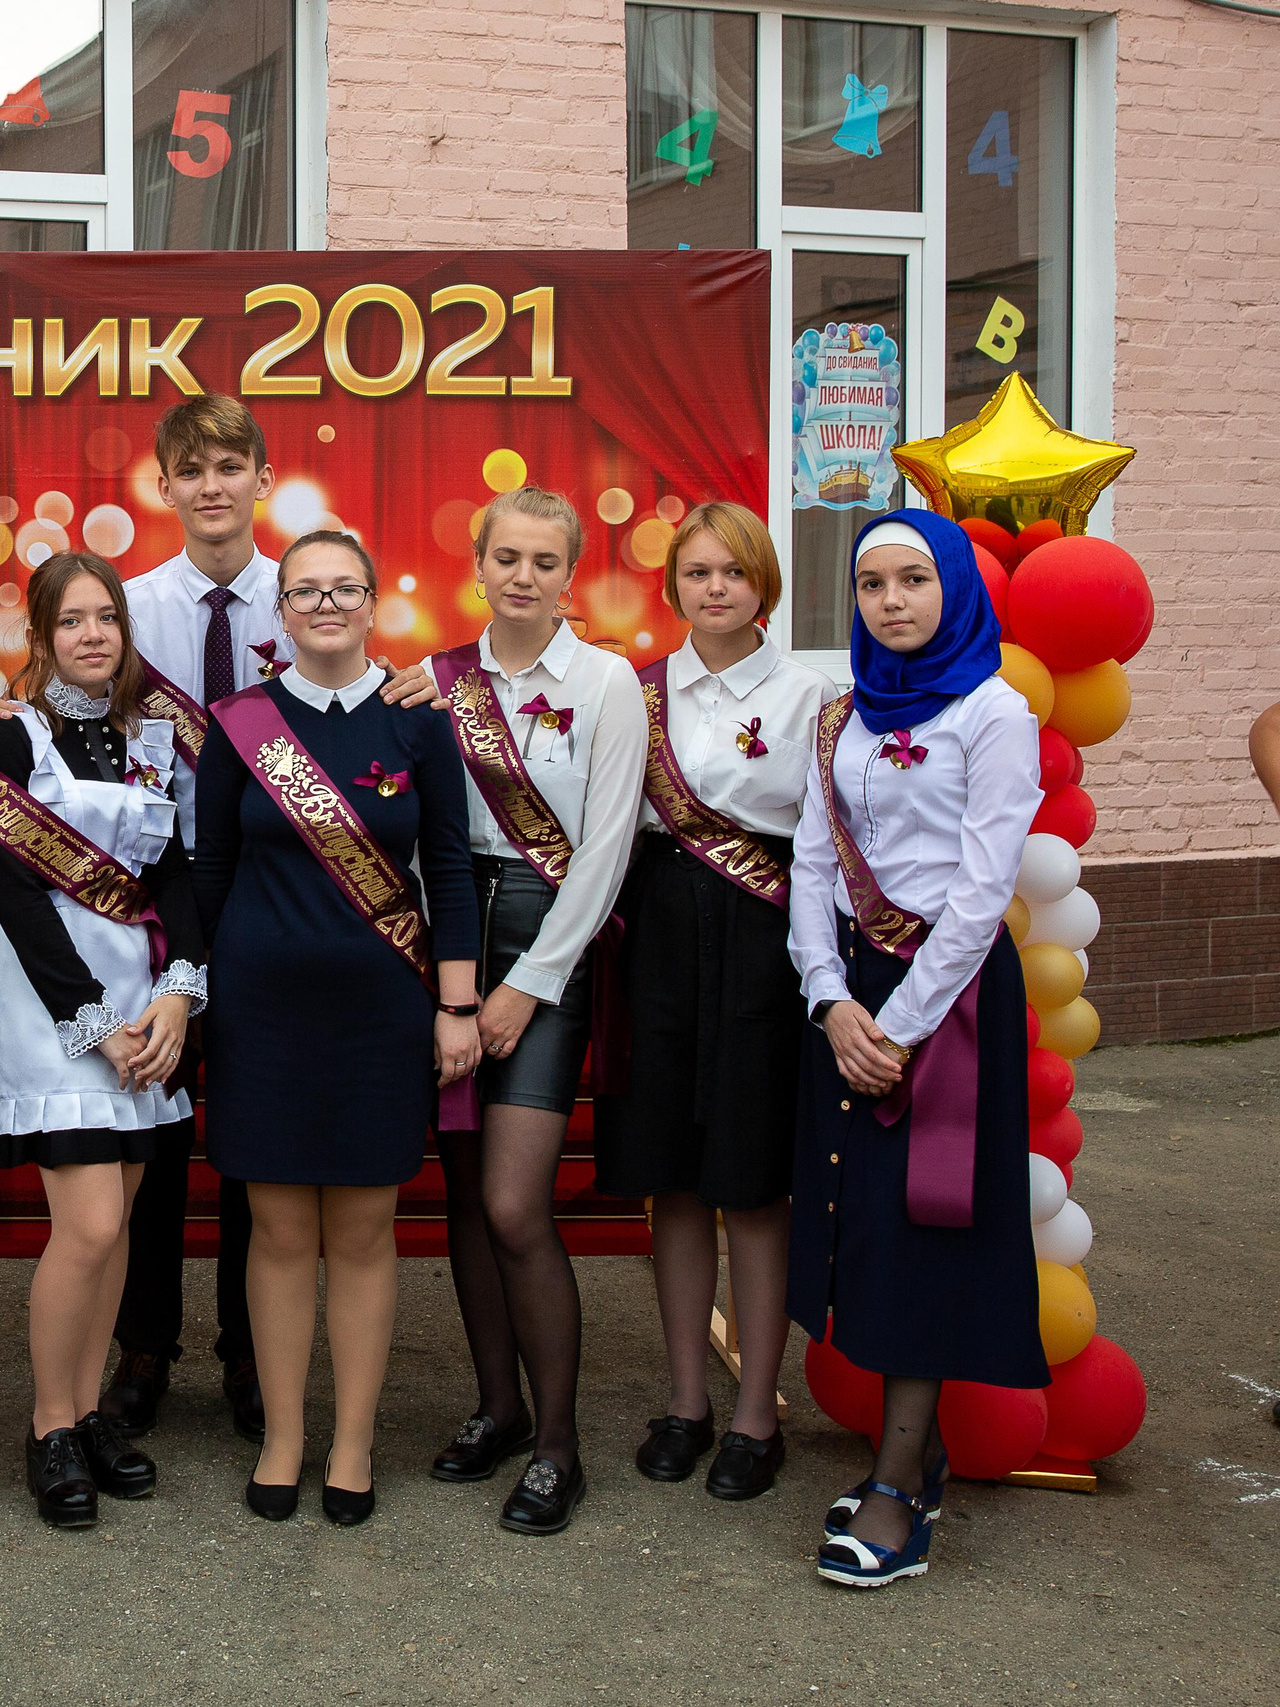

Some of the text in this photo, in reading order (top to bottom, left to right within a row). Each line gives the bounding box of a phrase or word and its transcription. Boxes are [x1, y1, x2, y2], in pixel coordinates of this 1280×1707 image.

[166, 90, 232, 178] 5
[655, 107, 719, 187] 4
[967, 110, 1019, 187] 4
[239, 283, 574, 399] 2021
[826, 355, 837, 371] ДО
[818, 385, 883, 407] ЛЮБИМАЯ
[820, 424, 883, 451] ШКОЛА!
[289, 783, 400, 912] Выпускник
[705, 831, 786, 896] 2021
[848, 874, 922, 954] 2021
